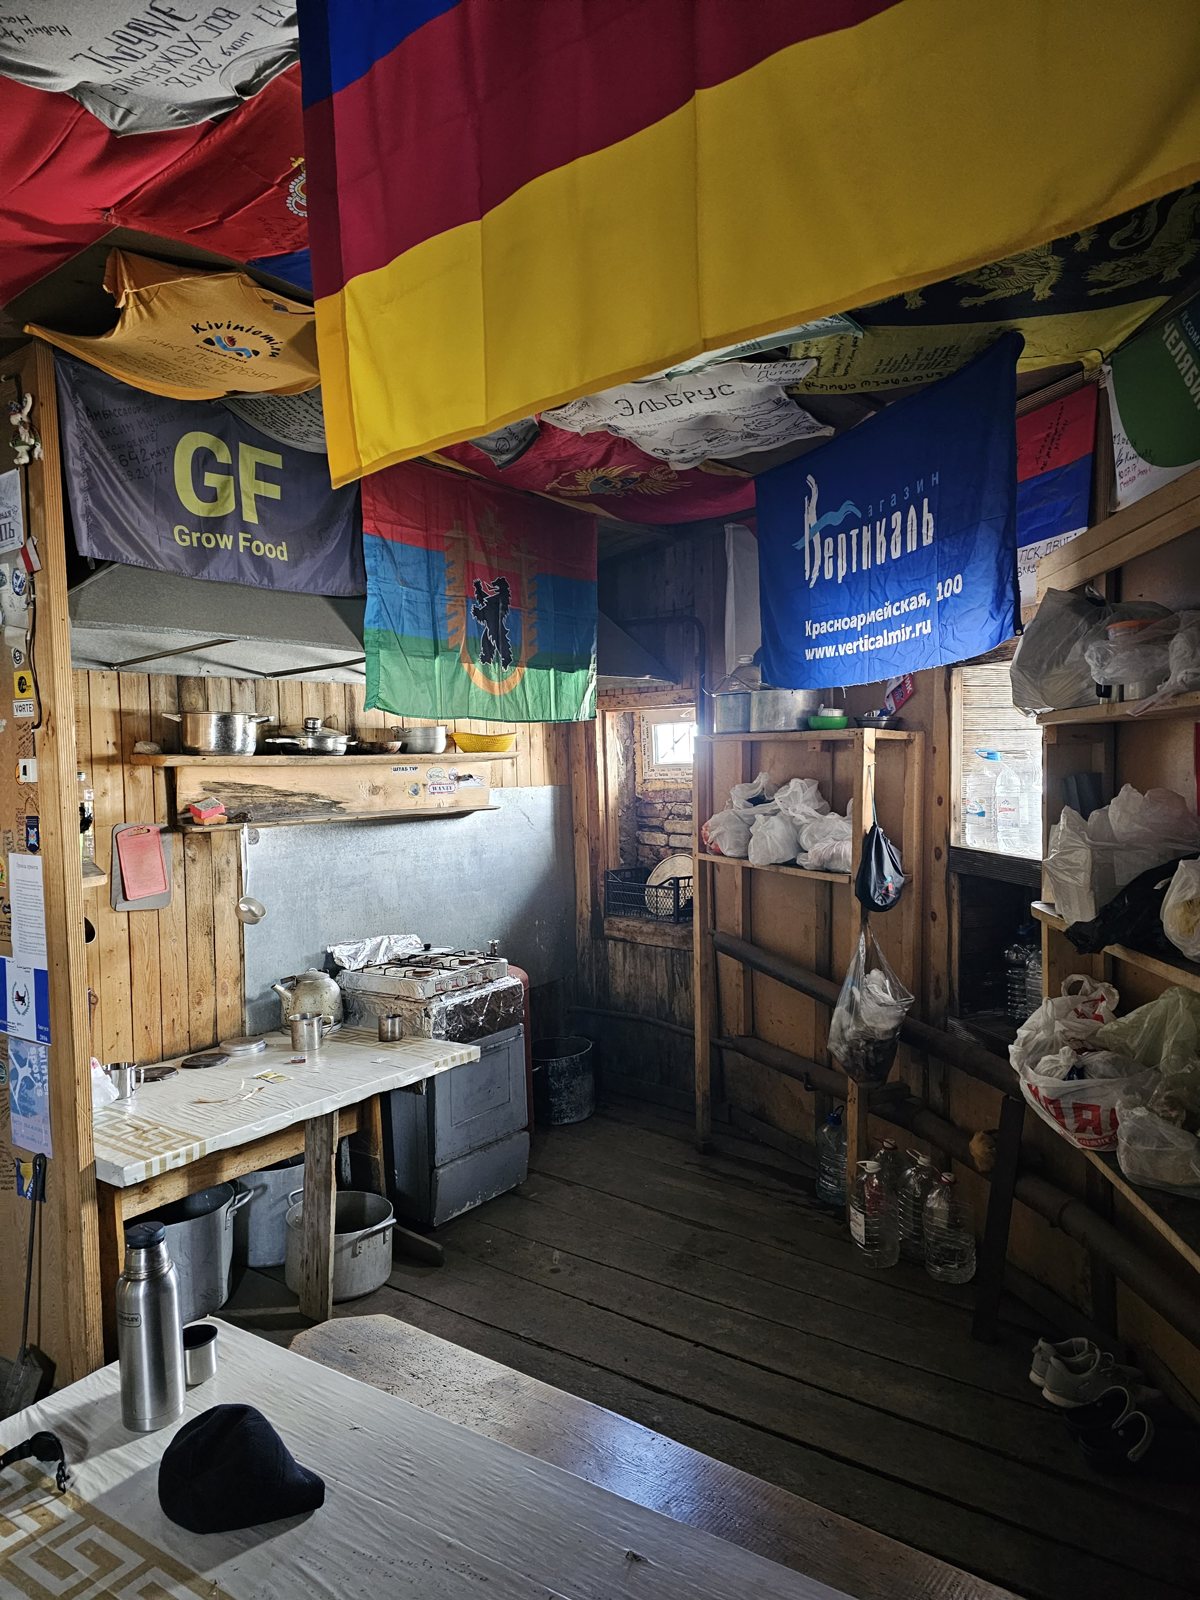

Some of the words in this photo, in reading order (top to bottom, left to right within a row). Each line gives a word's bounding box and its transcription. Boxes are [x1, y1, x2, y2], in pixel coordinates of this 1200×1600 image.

[1161, 319, 1200, 412] ЧЕЛЯБИ
[614, 384, 736, 417] ЭЛЬБРУС
[174, 431, 283, 524] GF
[173, 525, 233, 550] Grow
[238, 532, 288, 561] Food
[804, 474, 935, 589] Вертикаль
[805, 593, 931, 639] Красноармейская,
[936, 574, 963, 602] 100
[805, 619, 932, 660] www.verticalmir.ru
